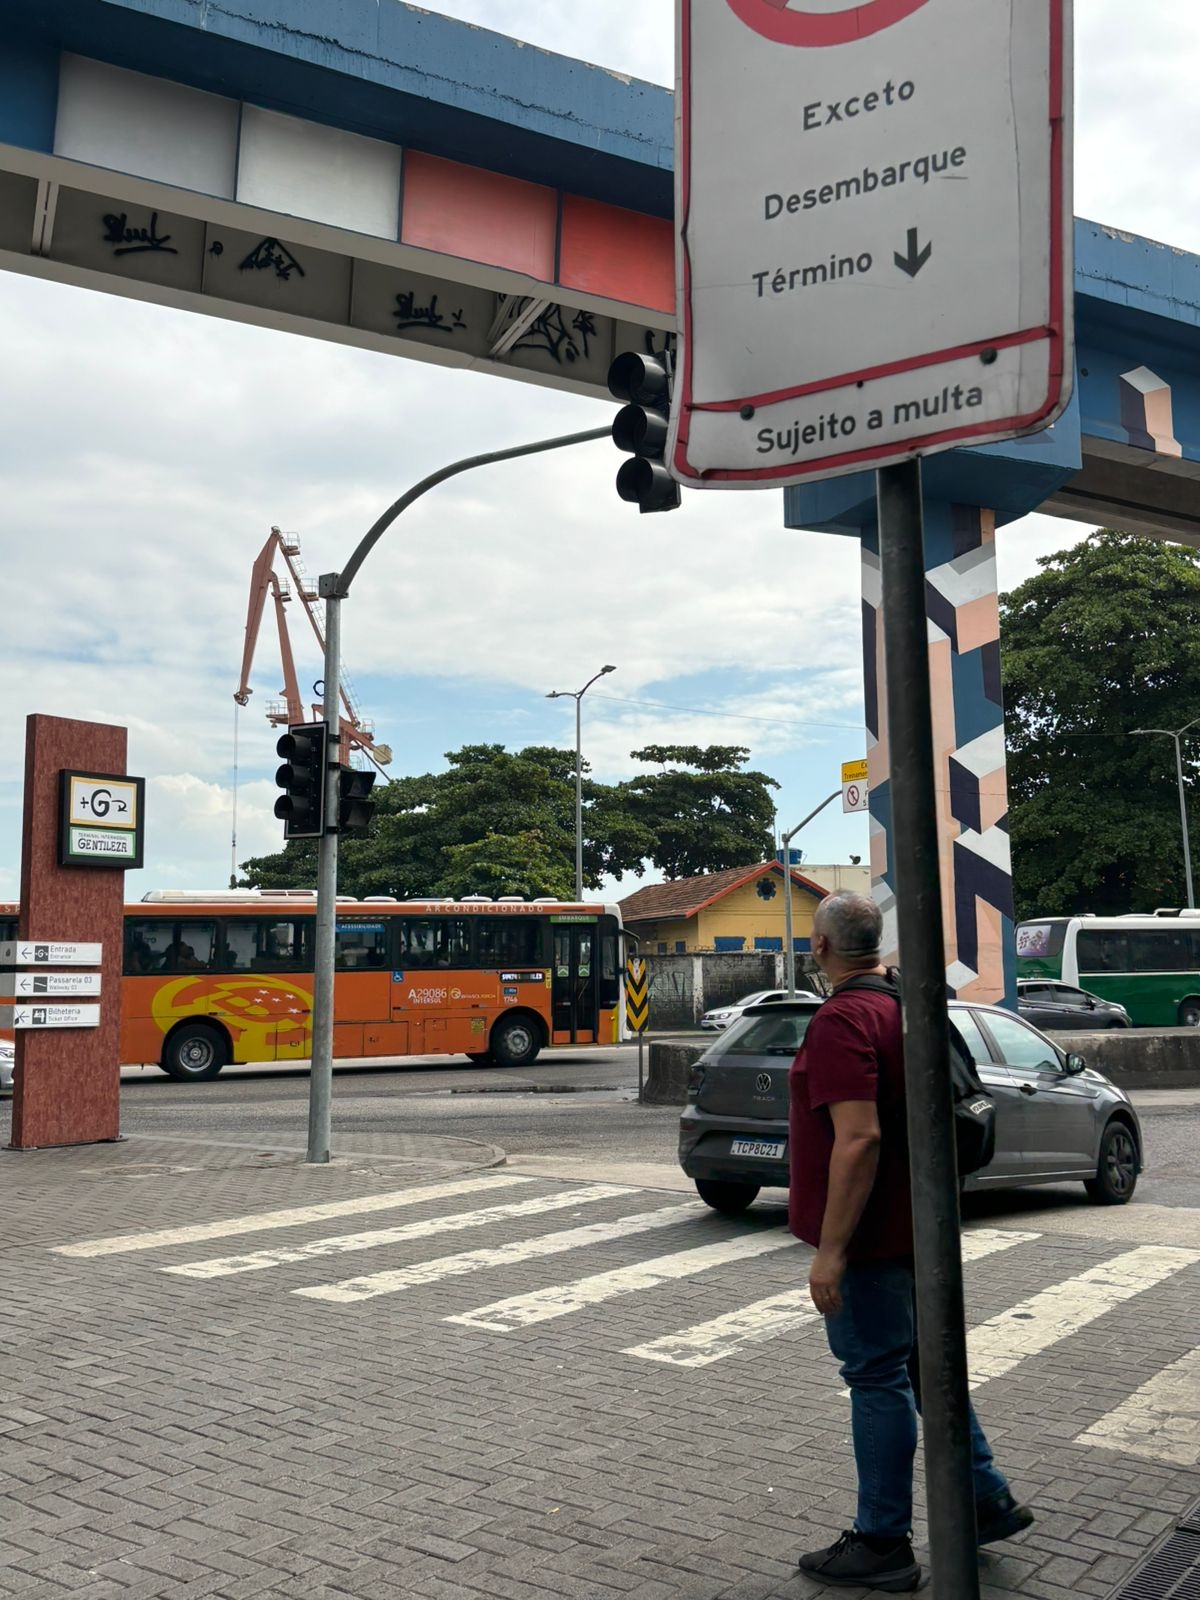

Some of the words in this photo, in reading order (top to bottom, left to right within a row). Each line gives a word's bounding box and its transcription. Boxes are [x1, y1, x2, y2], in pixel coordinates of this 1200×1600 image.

[803, 79, 915, 131] Exceto
[764, 146, 967, 220] Desembarque
[752, 252, 873, 297] Término
[756, 412, 856, 455] Sujeito
[867, 409, 883, 430] a
[893, 384, 983, 425] multa
[78, 838, 128, 853] GENTILEZA
[50, 945, 77, 953] Entrada
[49, 976, 82, 984] Passarela
[84, 976, 93, 984] 03
[408, 987, 447, 999] A29086
[737, 1142, 779, 1157] TCP8C21
